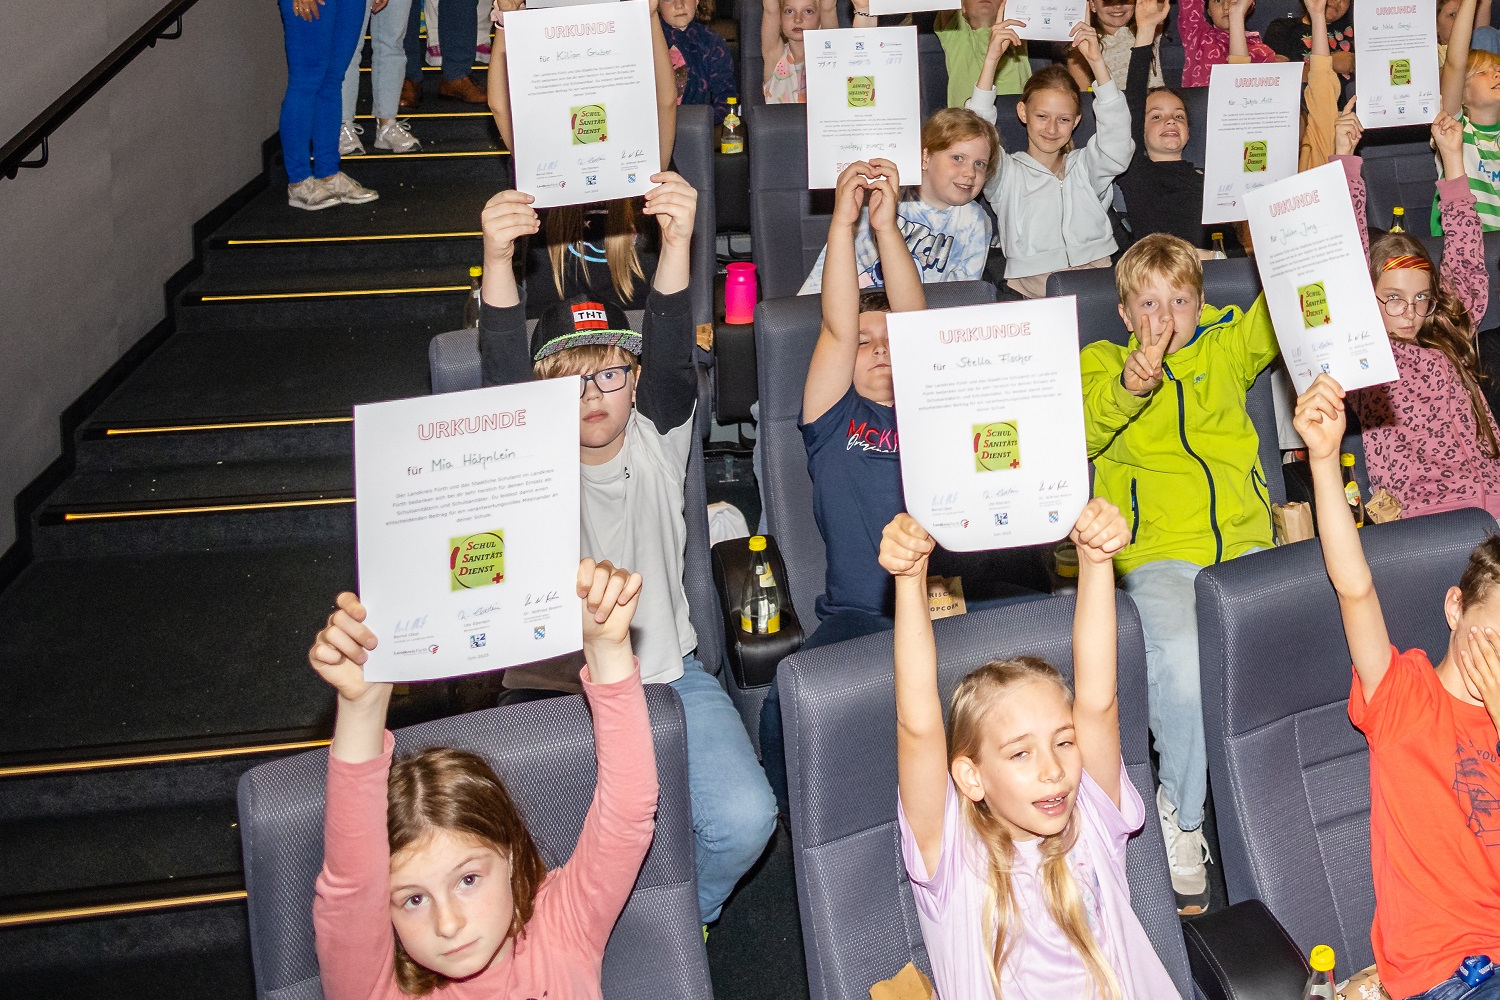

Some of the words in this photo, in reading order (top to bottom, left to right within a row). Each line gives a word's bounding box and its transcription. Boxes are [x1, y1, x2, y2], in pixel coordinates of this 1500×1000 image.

[1376, 5, 1417, 16] URKUNDE
[544, 21, 615, 39] URKUNDE
[556, 51, 581, 61] Kilian
[1234, 77, 1280, 89] URKUNDE
[579, 118, 606, 126] SANITÄTS
[1269, 190, 1320, 218] URKUNDE
[1306, 308, 1324, 318] DIENST
[939, 322, 1031, 344] URKUNDE
[956, 357, 992, 369] Stella
[997, 353, 1033, 365] Fischer
[418, 409, 526, 440] URKUNDE
[986, 429, 1012, 437] SCHUL
[983, 439, 1018, 449] SANITÄTS
[981, 451, 1011, 459] DIENST
[407, 465, 423, 476] für
[431, 459, 453, 472] Mia
[466, 541, 497, 551] SCHUL
[462, 551, 503, 563] SANITÄTS
[458, 564, 495, 576] DIENST
